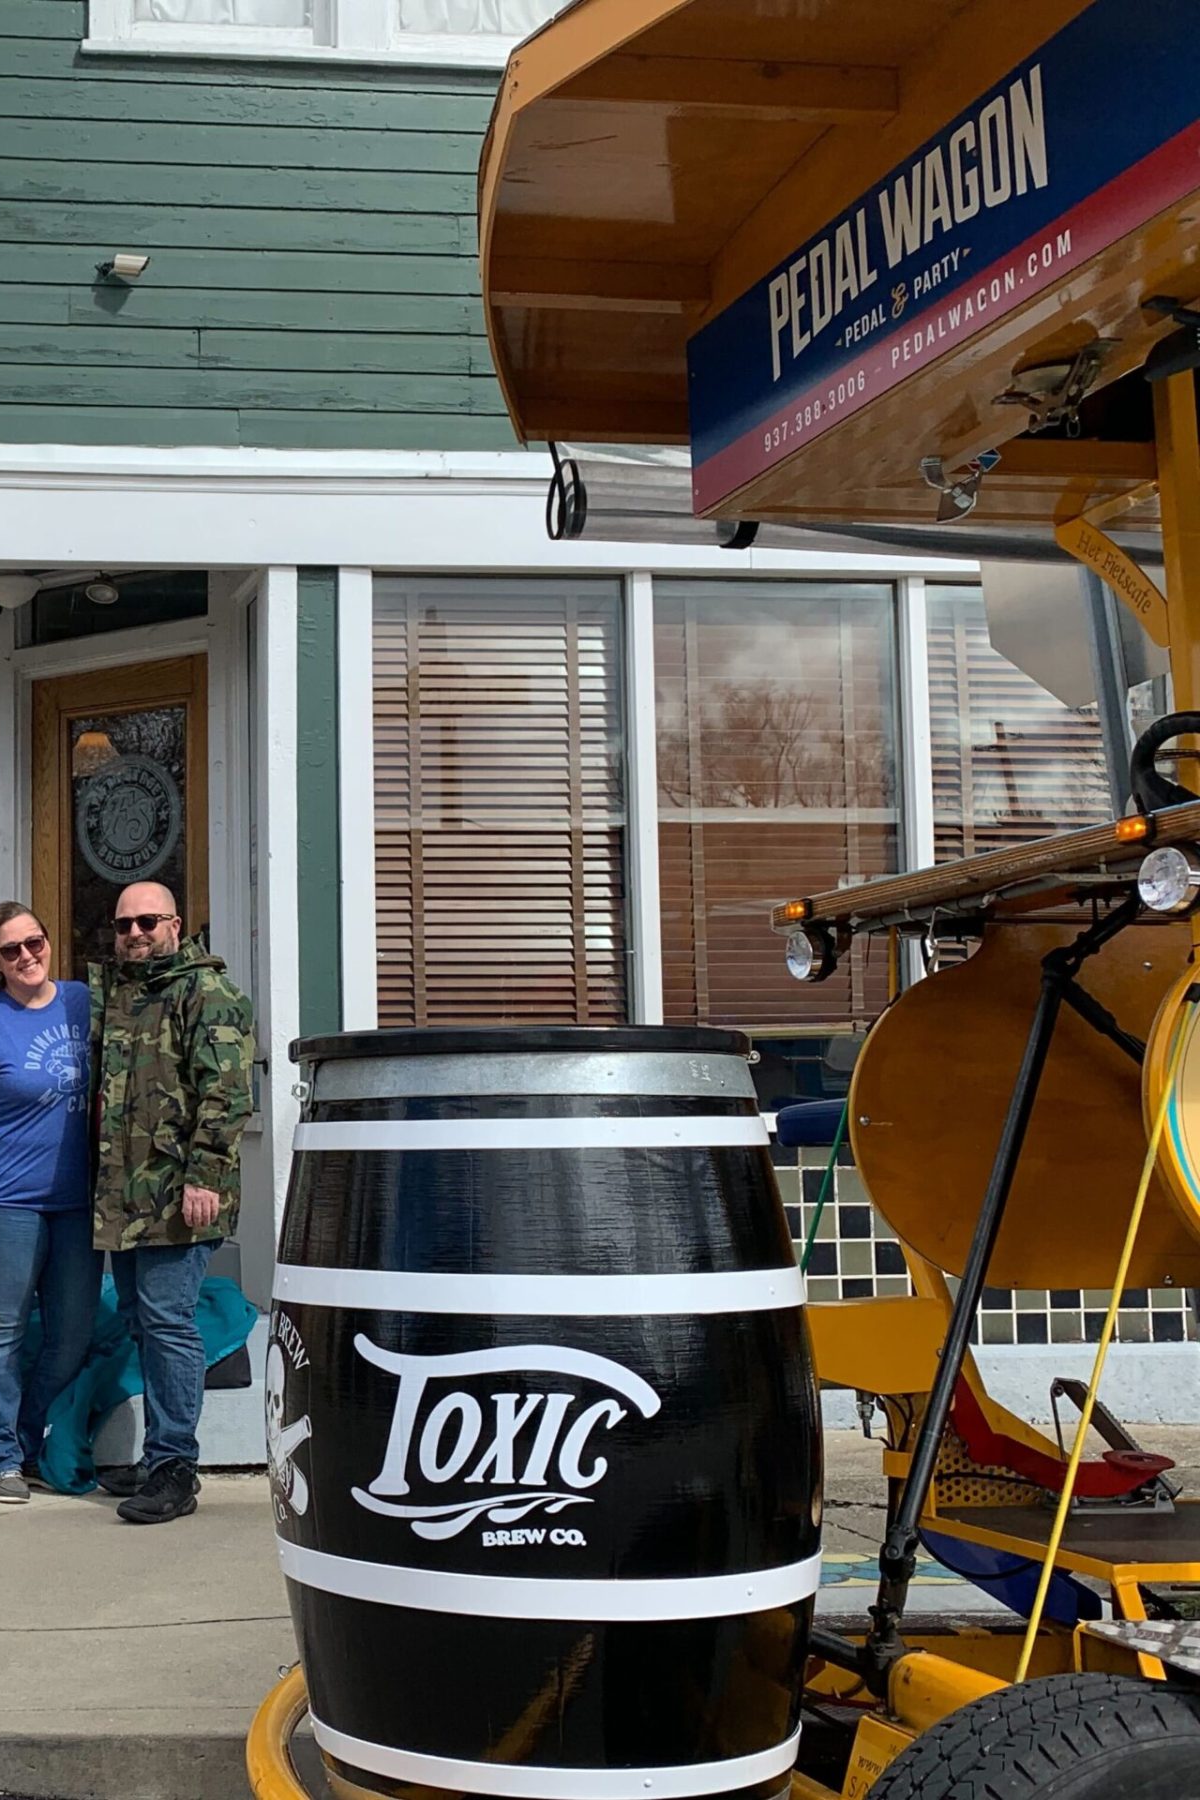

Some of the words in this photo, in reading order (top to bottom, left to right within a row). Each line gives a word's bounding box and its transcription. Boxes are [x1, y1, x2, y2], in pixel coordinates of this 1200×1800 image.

[768, 208, 878, 383] PEDAL
[878, 63, 1048, 270] WAGON
[845, 303, 887, 348] PEDAL
[914, 247, 961, 300] PARTY
[764, 370, 866, 453] 937.388.3006
[891, 228, 1072, 370] PEDALWAGON.COM
[98, 840, 158, 868] BREWPUB
[23, 1023, 80, 1070] DRINKING
[38, 1087, 64, 1109] MY
[278, 1311, 311, 1370] BREW
[482, 1528, 547, 1547] BREW
[549, 1528, 587, 1546] CO.
